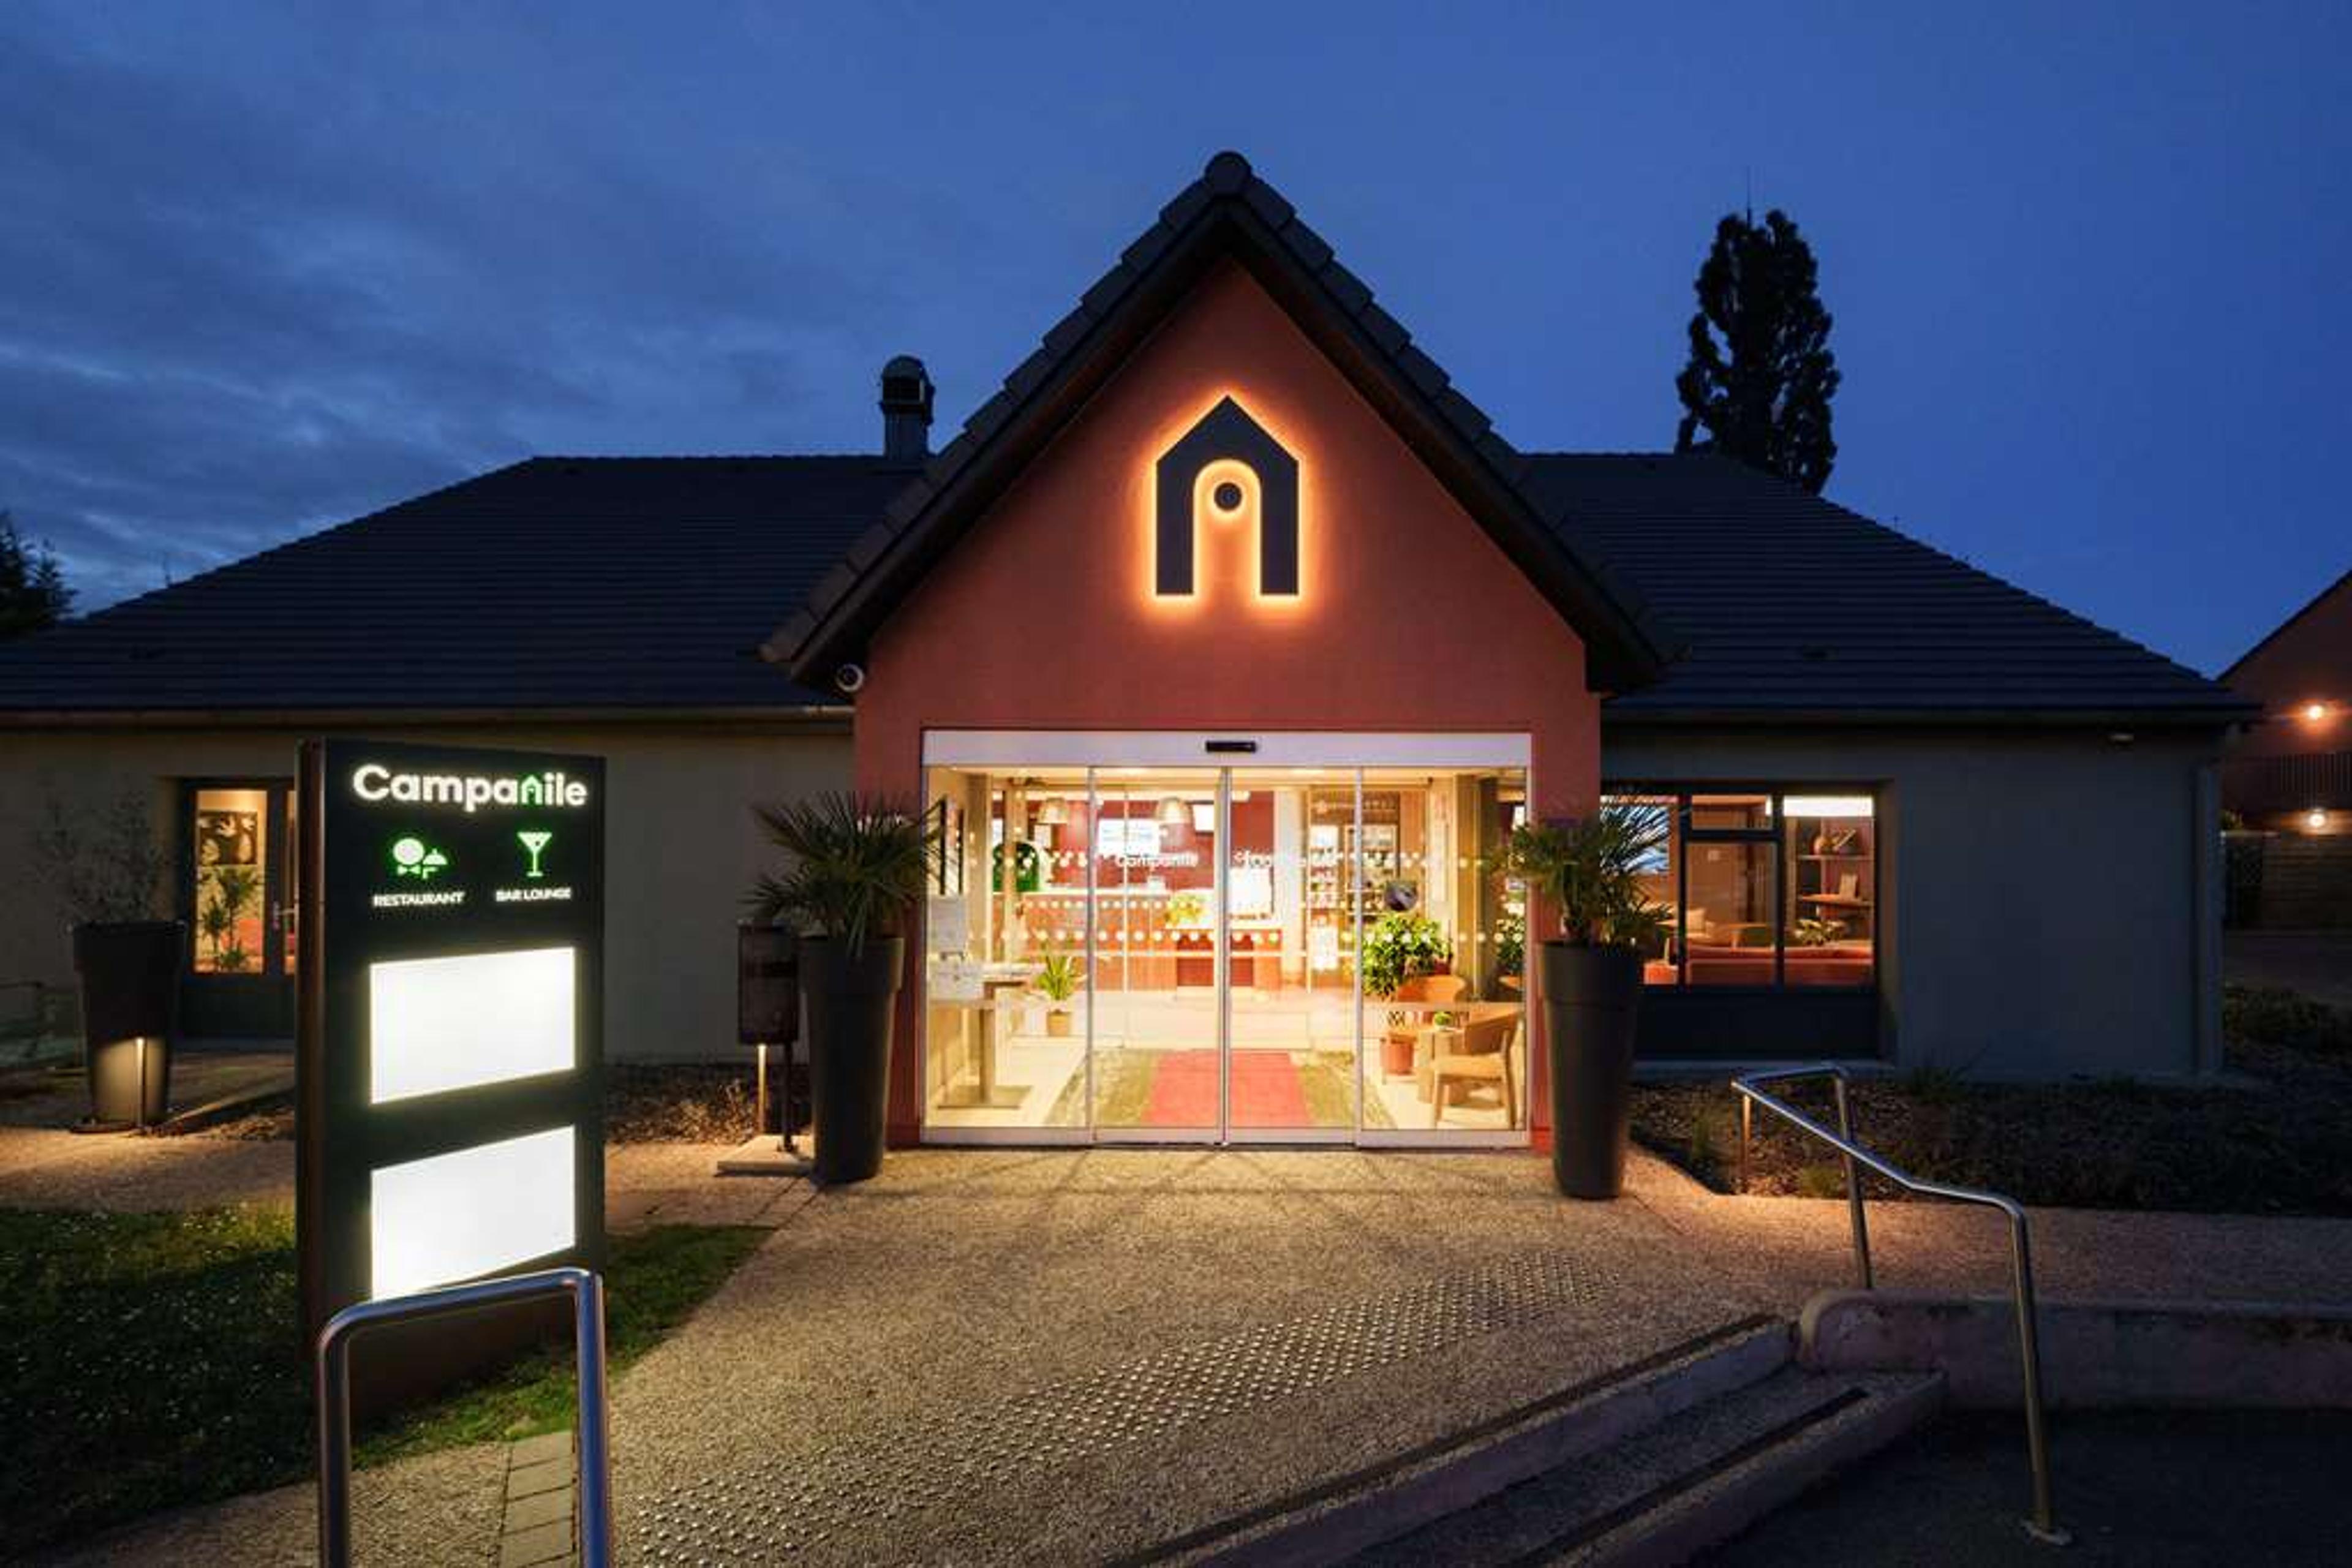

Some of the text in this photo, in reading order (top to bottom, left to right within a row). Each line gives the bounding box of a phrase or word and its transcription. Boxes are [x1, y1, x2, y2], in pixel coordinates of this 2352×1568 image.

[353, 764, 588, 812] Campanile
[374, 892, 464, 907] RESTAURANT
[496, 888, 571, 902] BAR LOUNGE
